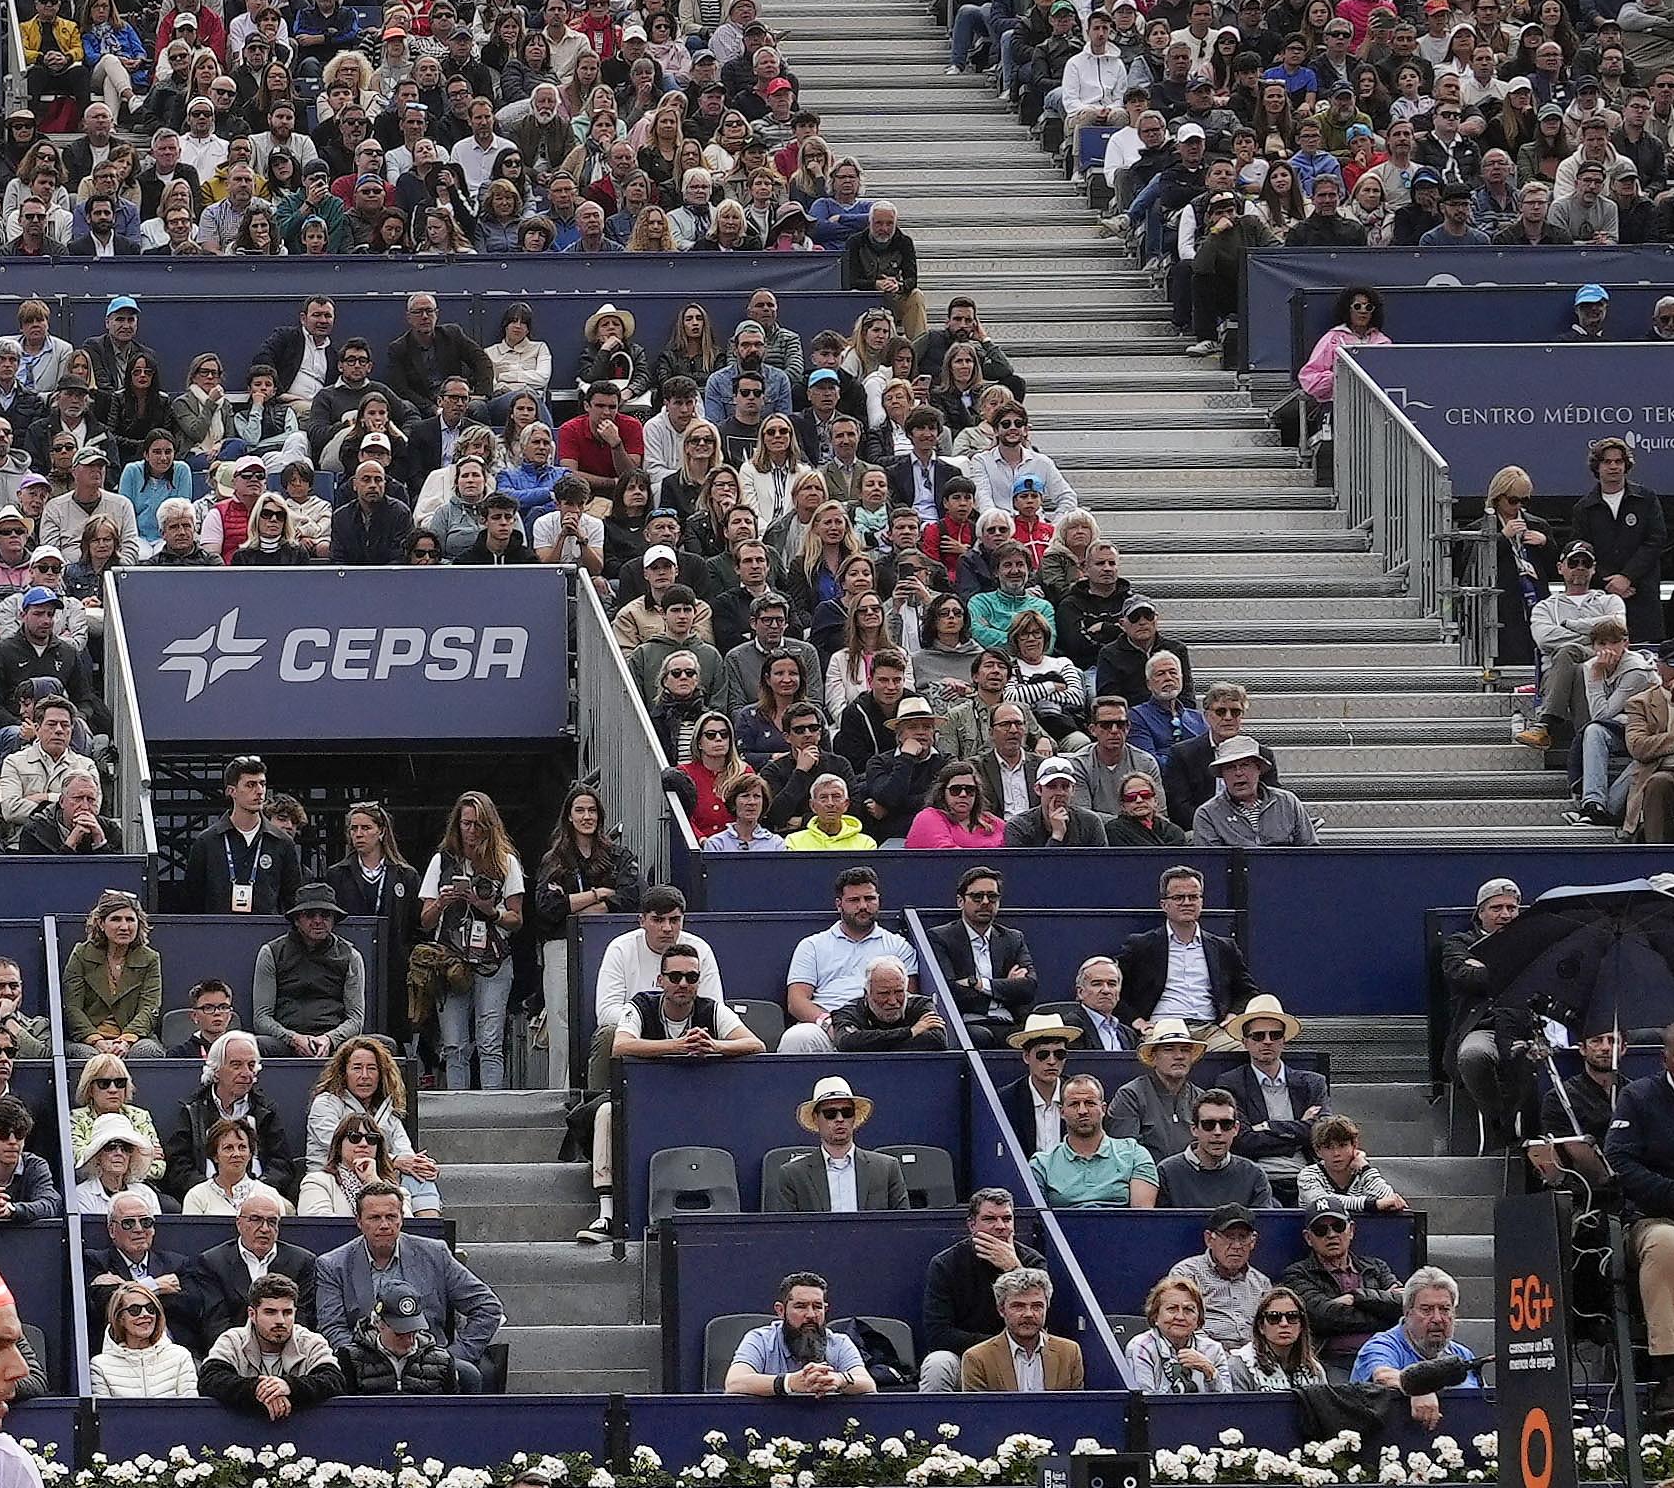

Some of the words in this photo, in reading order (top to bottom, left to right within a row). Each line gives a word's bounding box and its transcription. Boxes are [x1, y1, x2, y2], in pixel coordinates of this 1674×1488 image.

[1445, 407, 1535, 424] CENTRO
[1543, 403, 1634, 424] MÉDICO
[279, 626, 529, 682] CEPSA
[1509, 1274, 1555, 1332] 5G+
